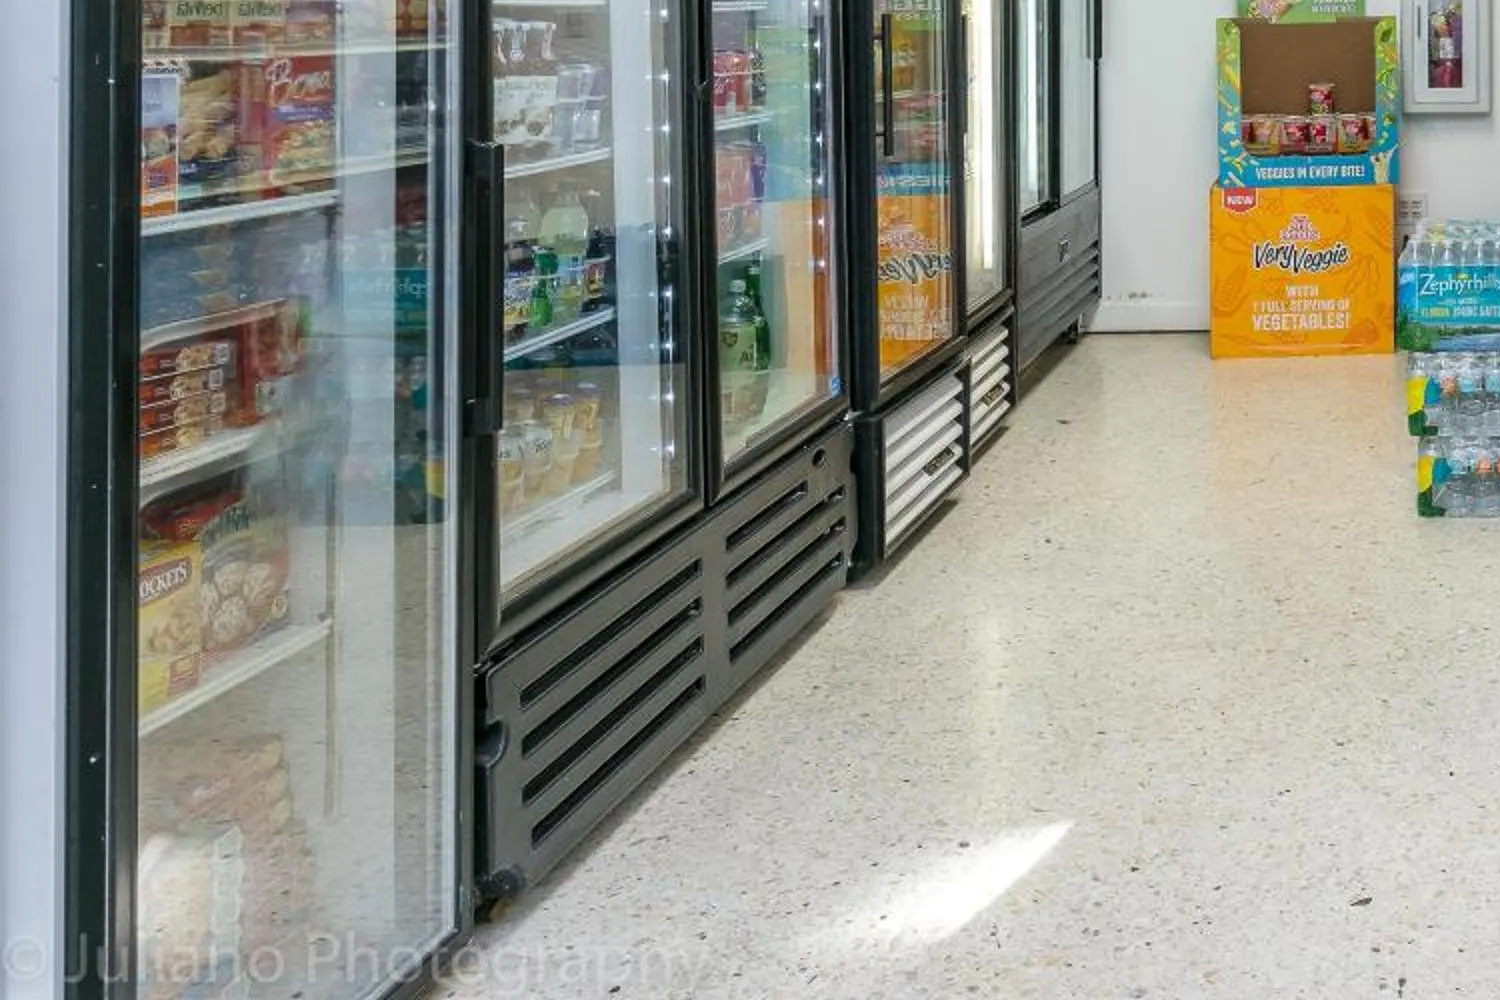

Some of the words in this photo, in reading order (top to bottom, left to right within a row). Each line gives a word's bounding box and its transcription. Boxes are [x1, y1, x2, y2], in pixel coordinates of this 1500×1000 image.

[1256, 167, 1295, 179] VEGGIES
[1299, 168, 1306, 178] IN
[1309, 167, 1338, 178] EVERY
[1341, 165, 1365, 177] BITE!
[1287, 284, 1319, 297] WITH
[1262, 301, 1286, 313] FULL
[1288, 299, 1335, 312] SERVING
[1252, 312, 1351, 332] VEGETABLES!
[139, 561, 188, 597] OCKETS
